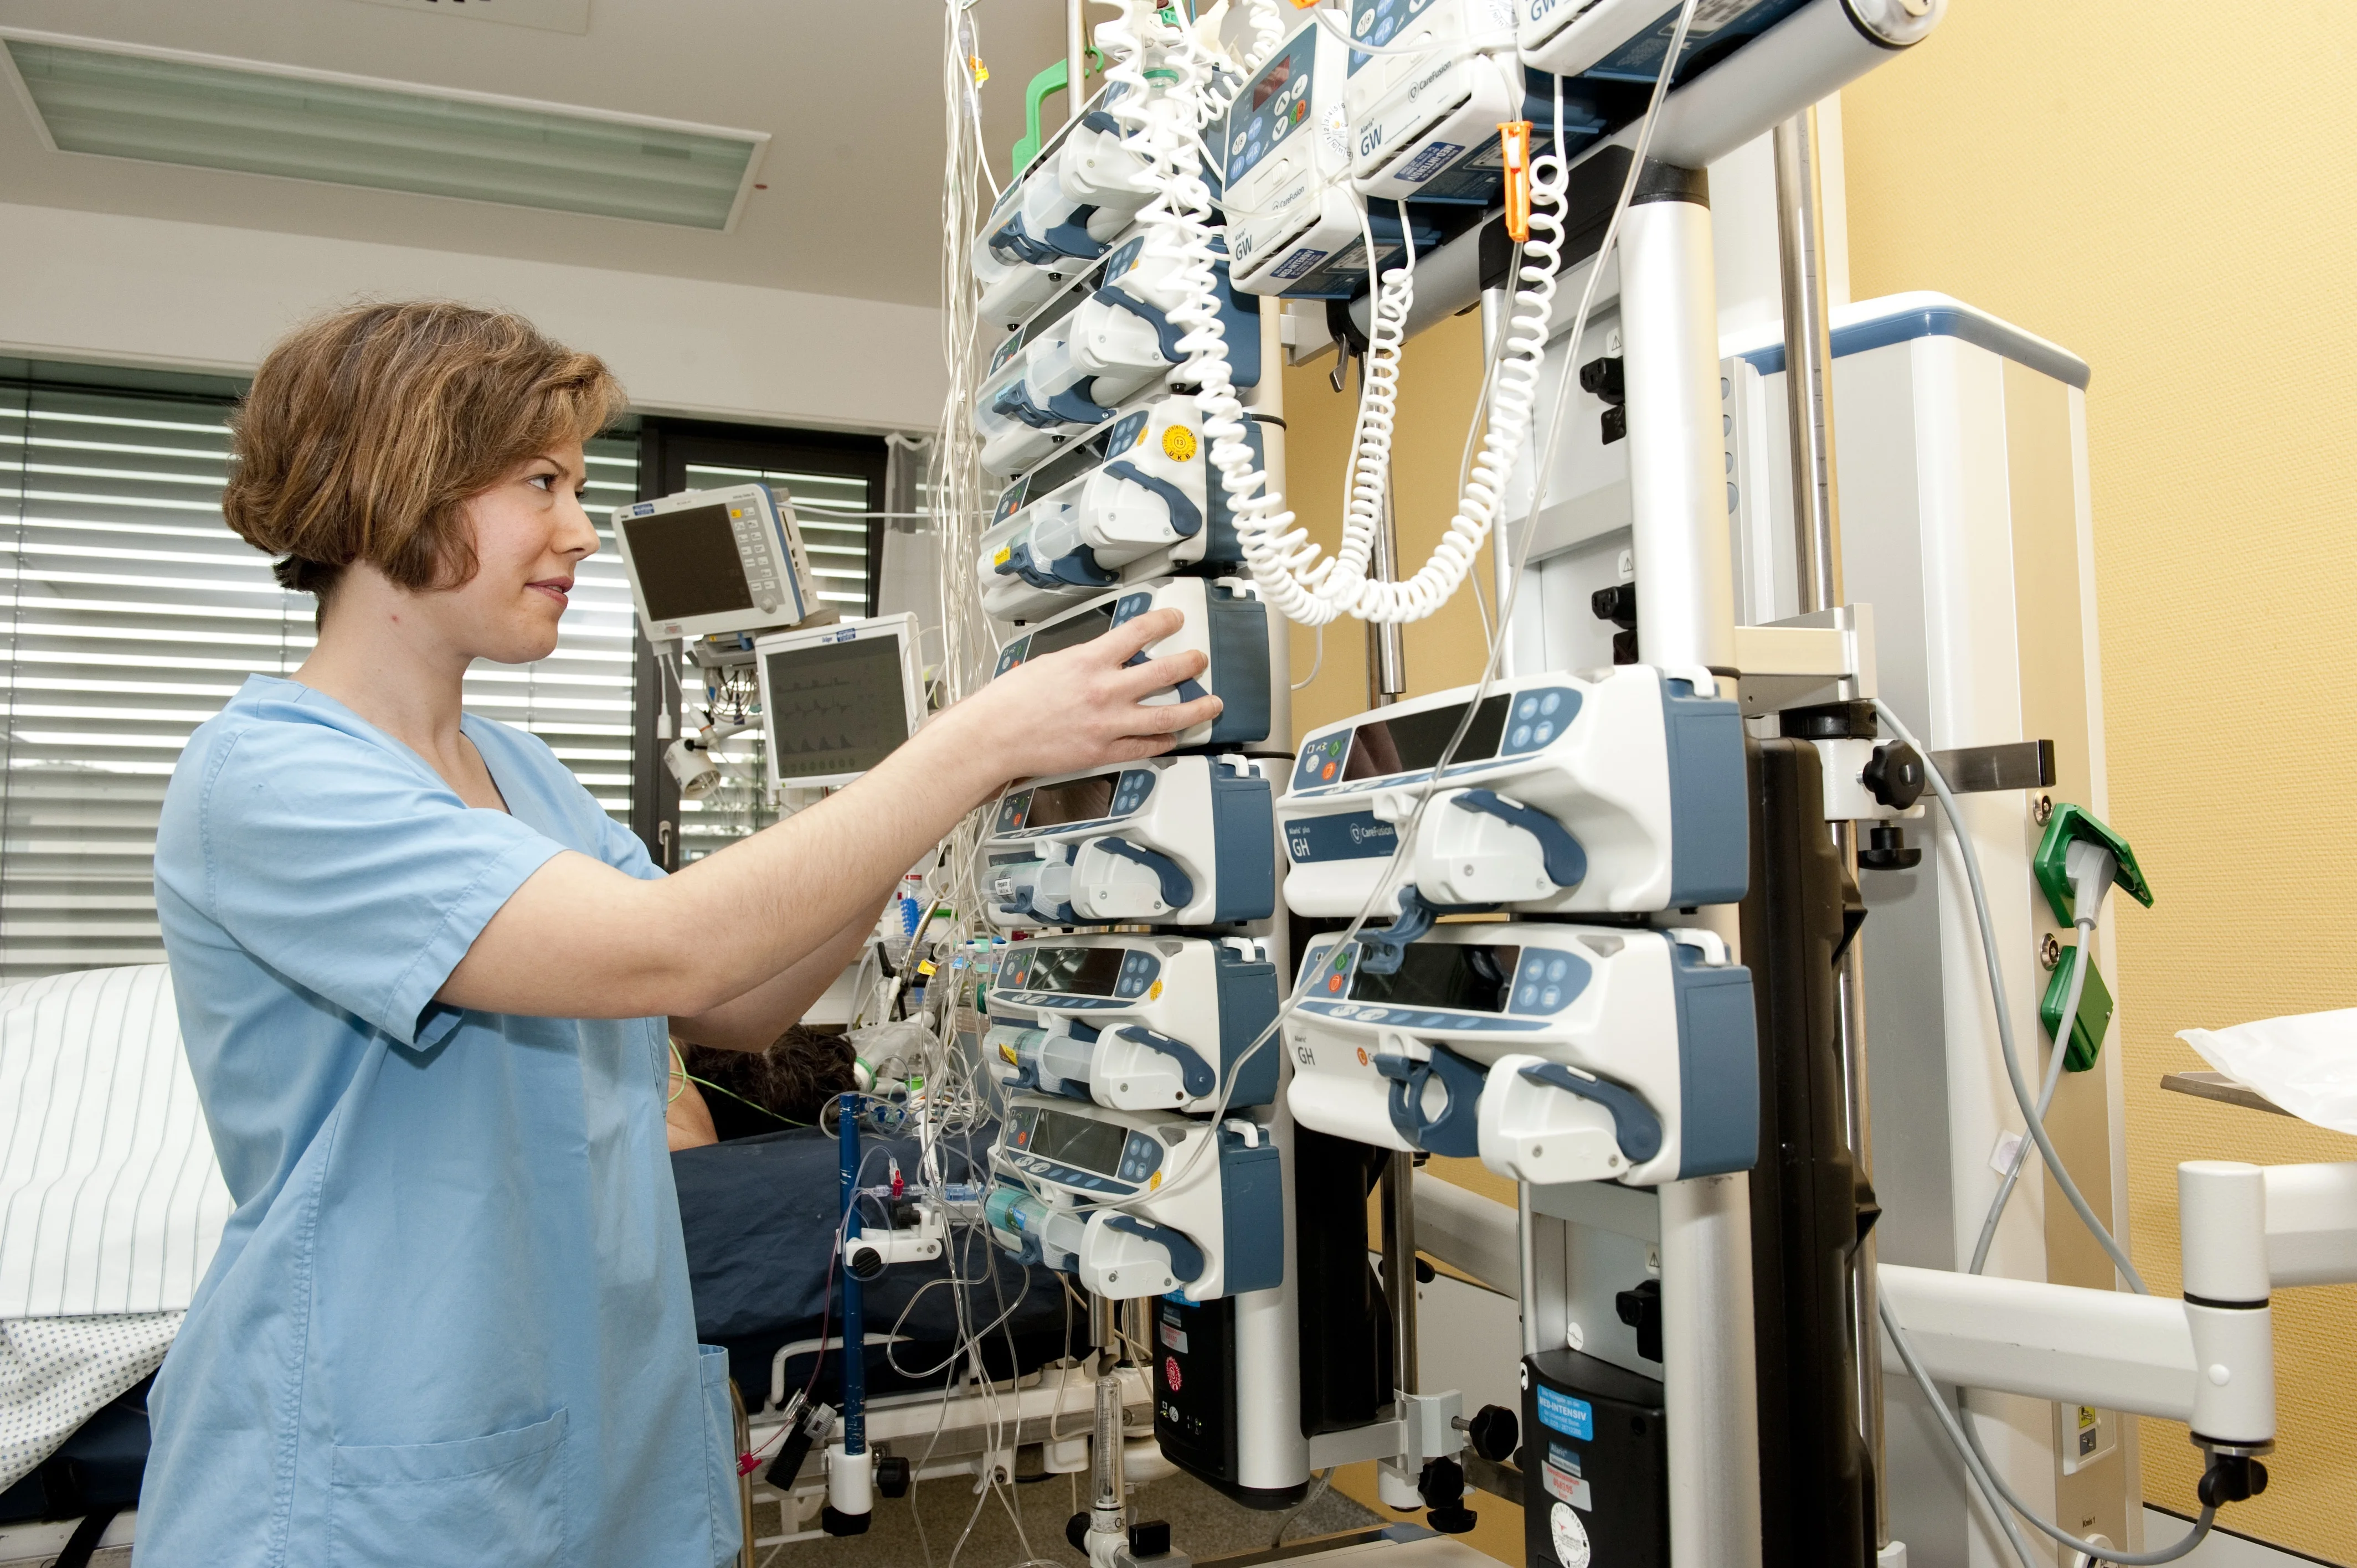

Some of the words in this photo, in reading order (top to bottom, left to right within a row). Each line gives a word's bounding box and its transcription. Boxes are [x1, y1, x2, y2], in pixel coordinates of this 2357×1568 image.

[1419, 61, 1451, 90] CareFusion
[1361, 123, 1382, 157] GW
[1280, 186, 1305, 208] CareFusion
[1236, 234, 1252, 261] GW
[1361, 825, 1394, 838] CareFusion
[1292, 837, 1311, 857] GH
[1298, 1046, 1315, 1066] GH
[1539, 1396, 1587, 1421] MED-INTENSIV
